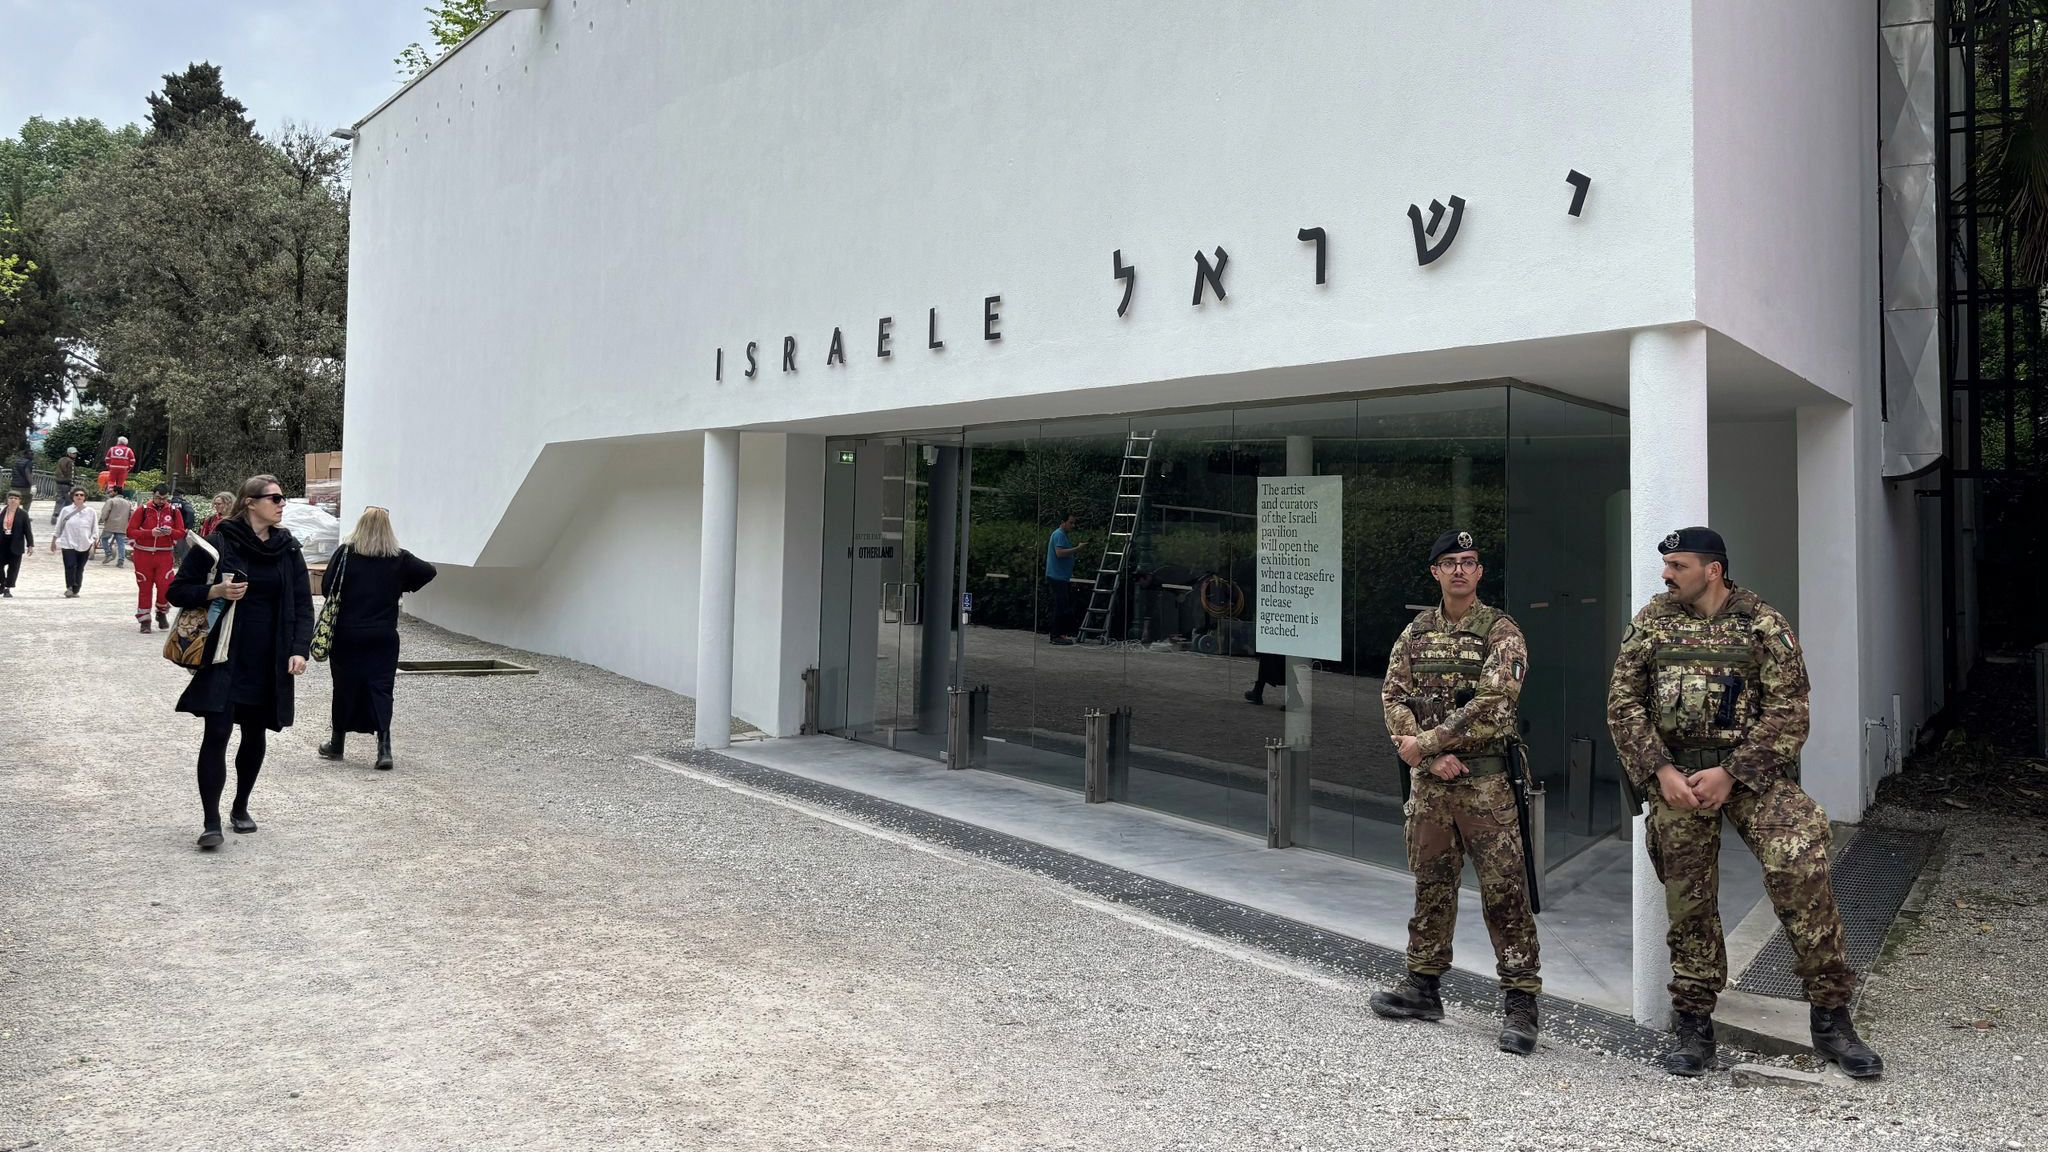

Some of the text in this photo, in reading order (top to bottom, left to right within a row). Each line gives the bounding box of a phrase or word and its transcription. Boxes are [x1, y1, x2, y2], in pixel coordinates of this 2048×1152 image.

[1113, 169, 1592, 318] ישראל
[716, 295, 1001, 381] ISRAELE
[1262, 484, 1305, 496] The artist
[1262, 498, 1318, 510] and curators
[1262, 512, 1318, 524] of the Israeli
[1262, 526, 1298, 540] pavilion
[1261, 540, 1318, 555] will open the
[1261, 554, 1310, 566] exhibition
[1261, 569, 1335, 582] when a ceasefire
[1261, 582, 1315, 598] and hostage
[1261, 596, 1292, 608] release
[1261, 612, 1318, 624] agreement is
[1261, 624, 1299, 638] reached.
